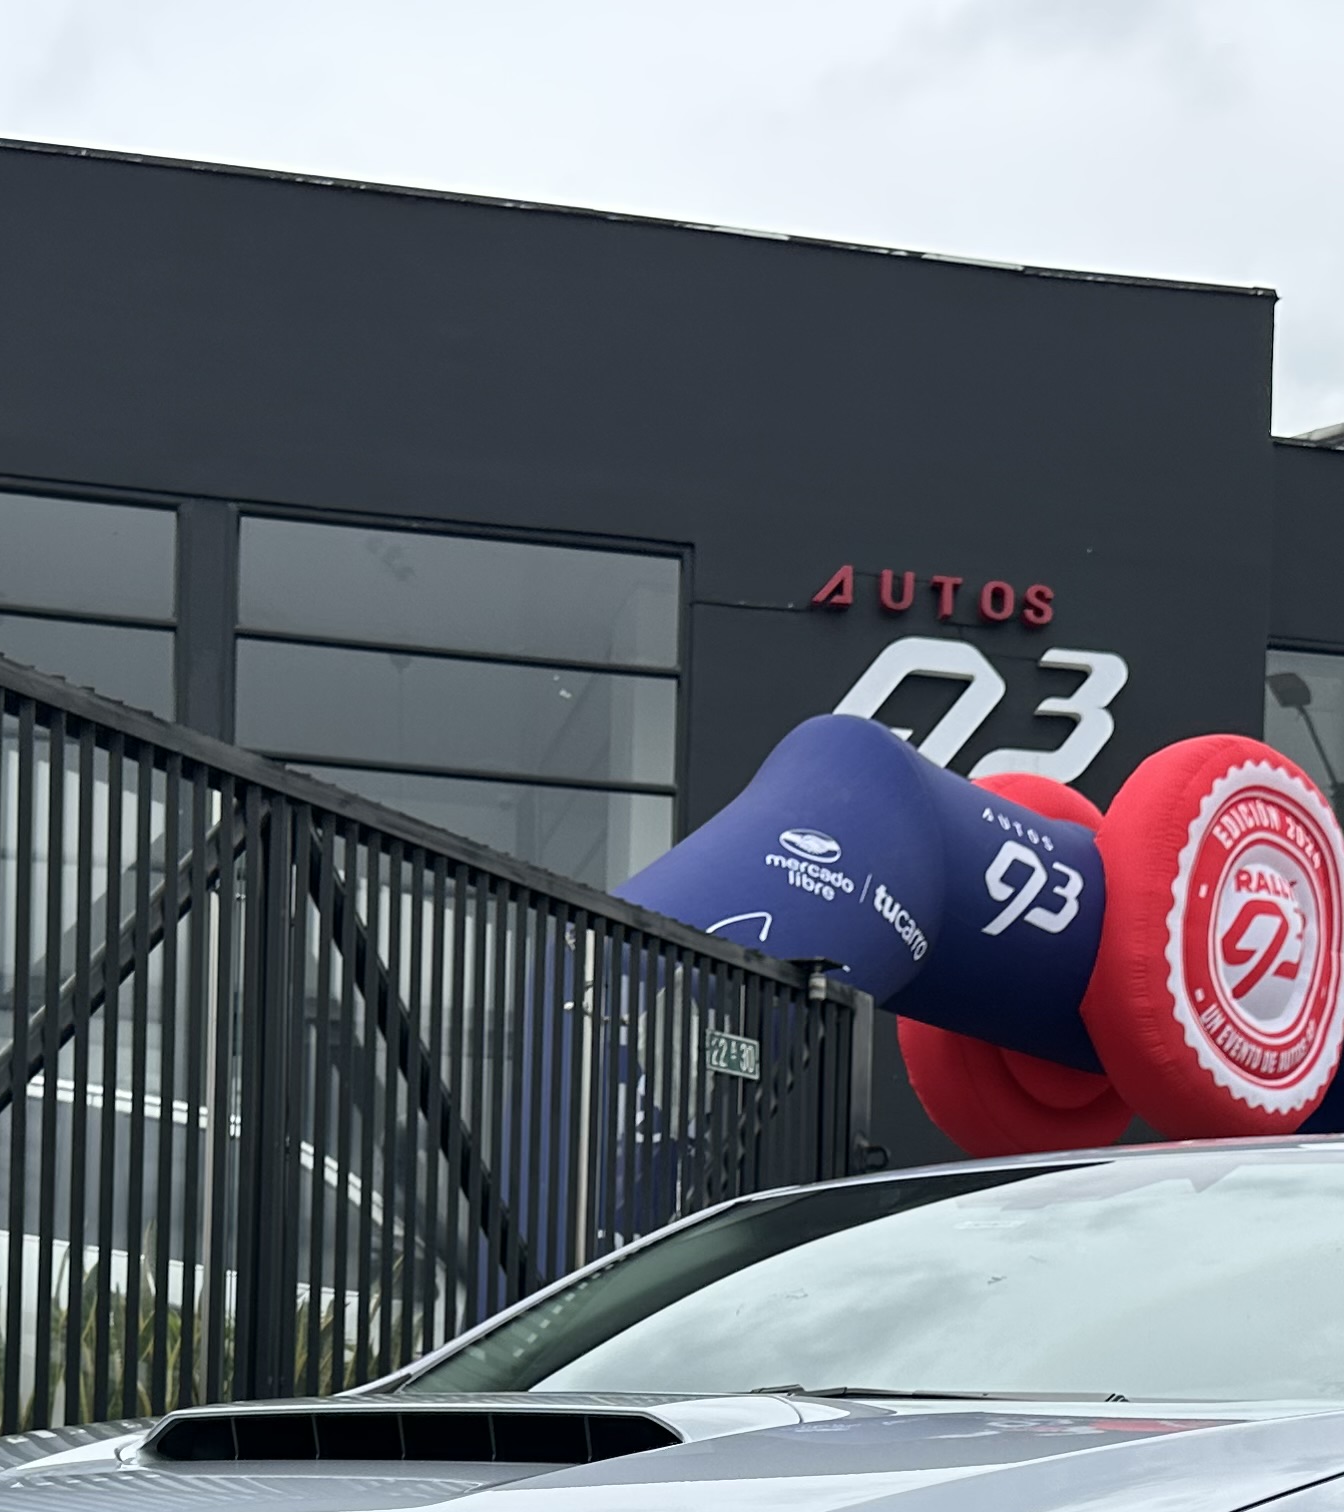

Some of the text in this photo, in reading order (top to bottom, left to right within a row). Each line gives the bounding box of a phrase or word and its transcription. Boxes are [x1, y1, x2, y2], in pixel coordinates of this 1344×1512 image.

[811, 564, 1055, 627] AUTOS
[832, 635, 1129, 784] 93
[981, 807, 1055, 852] AUTOS
[1286, 815, 1322, 870] 2024
[764, 853, 855, 895] mercado
[787, 869, 836, 902] libre
[980, 839, 1084, 937] 93
[872, 883, 928, 962] tucarro
[1200, 1002, 1225, 1035] UN
[1216, 1023, 1263, 1070] EVENTO
